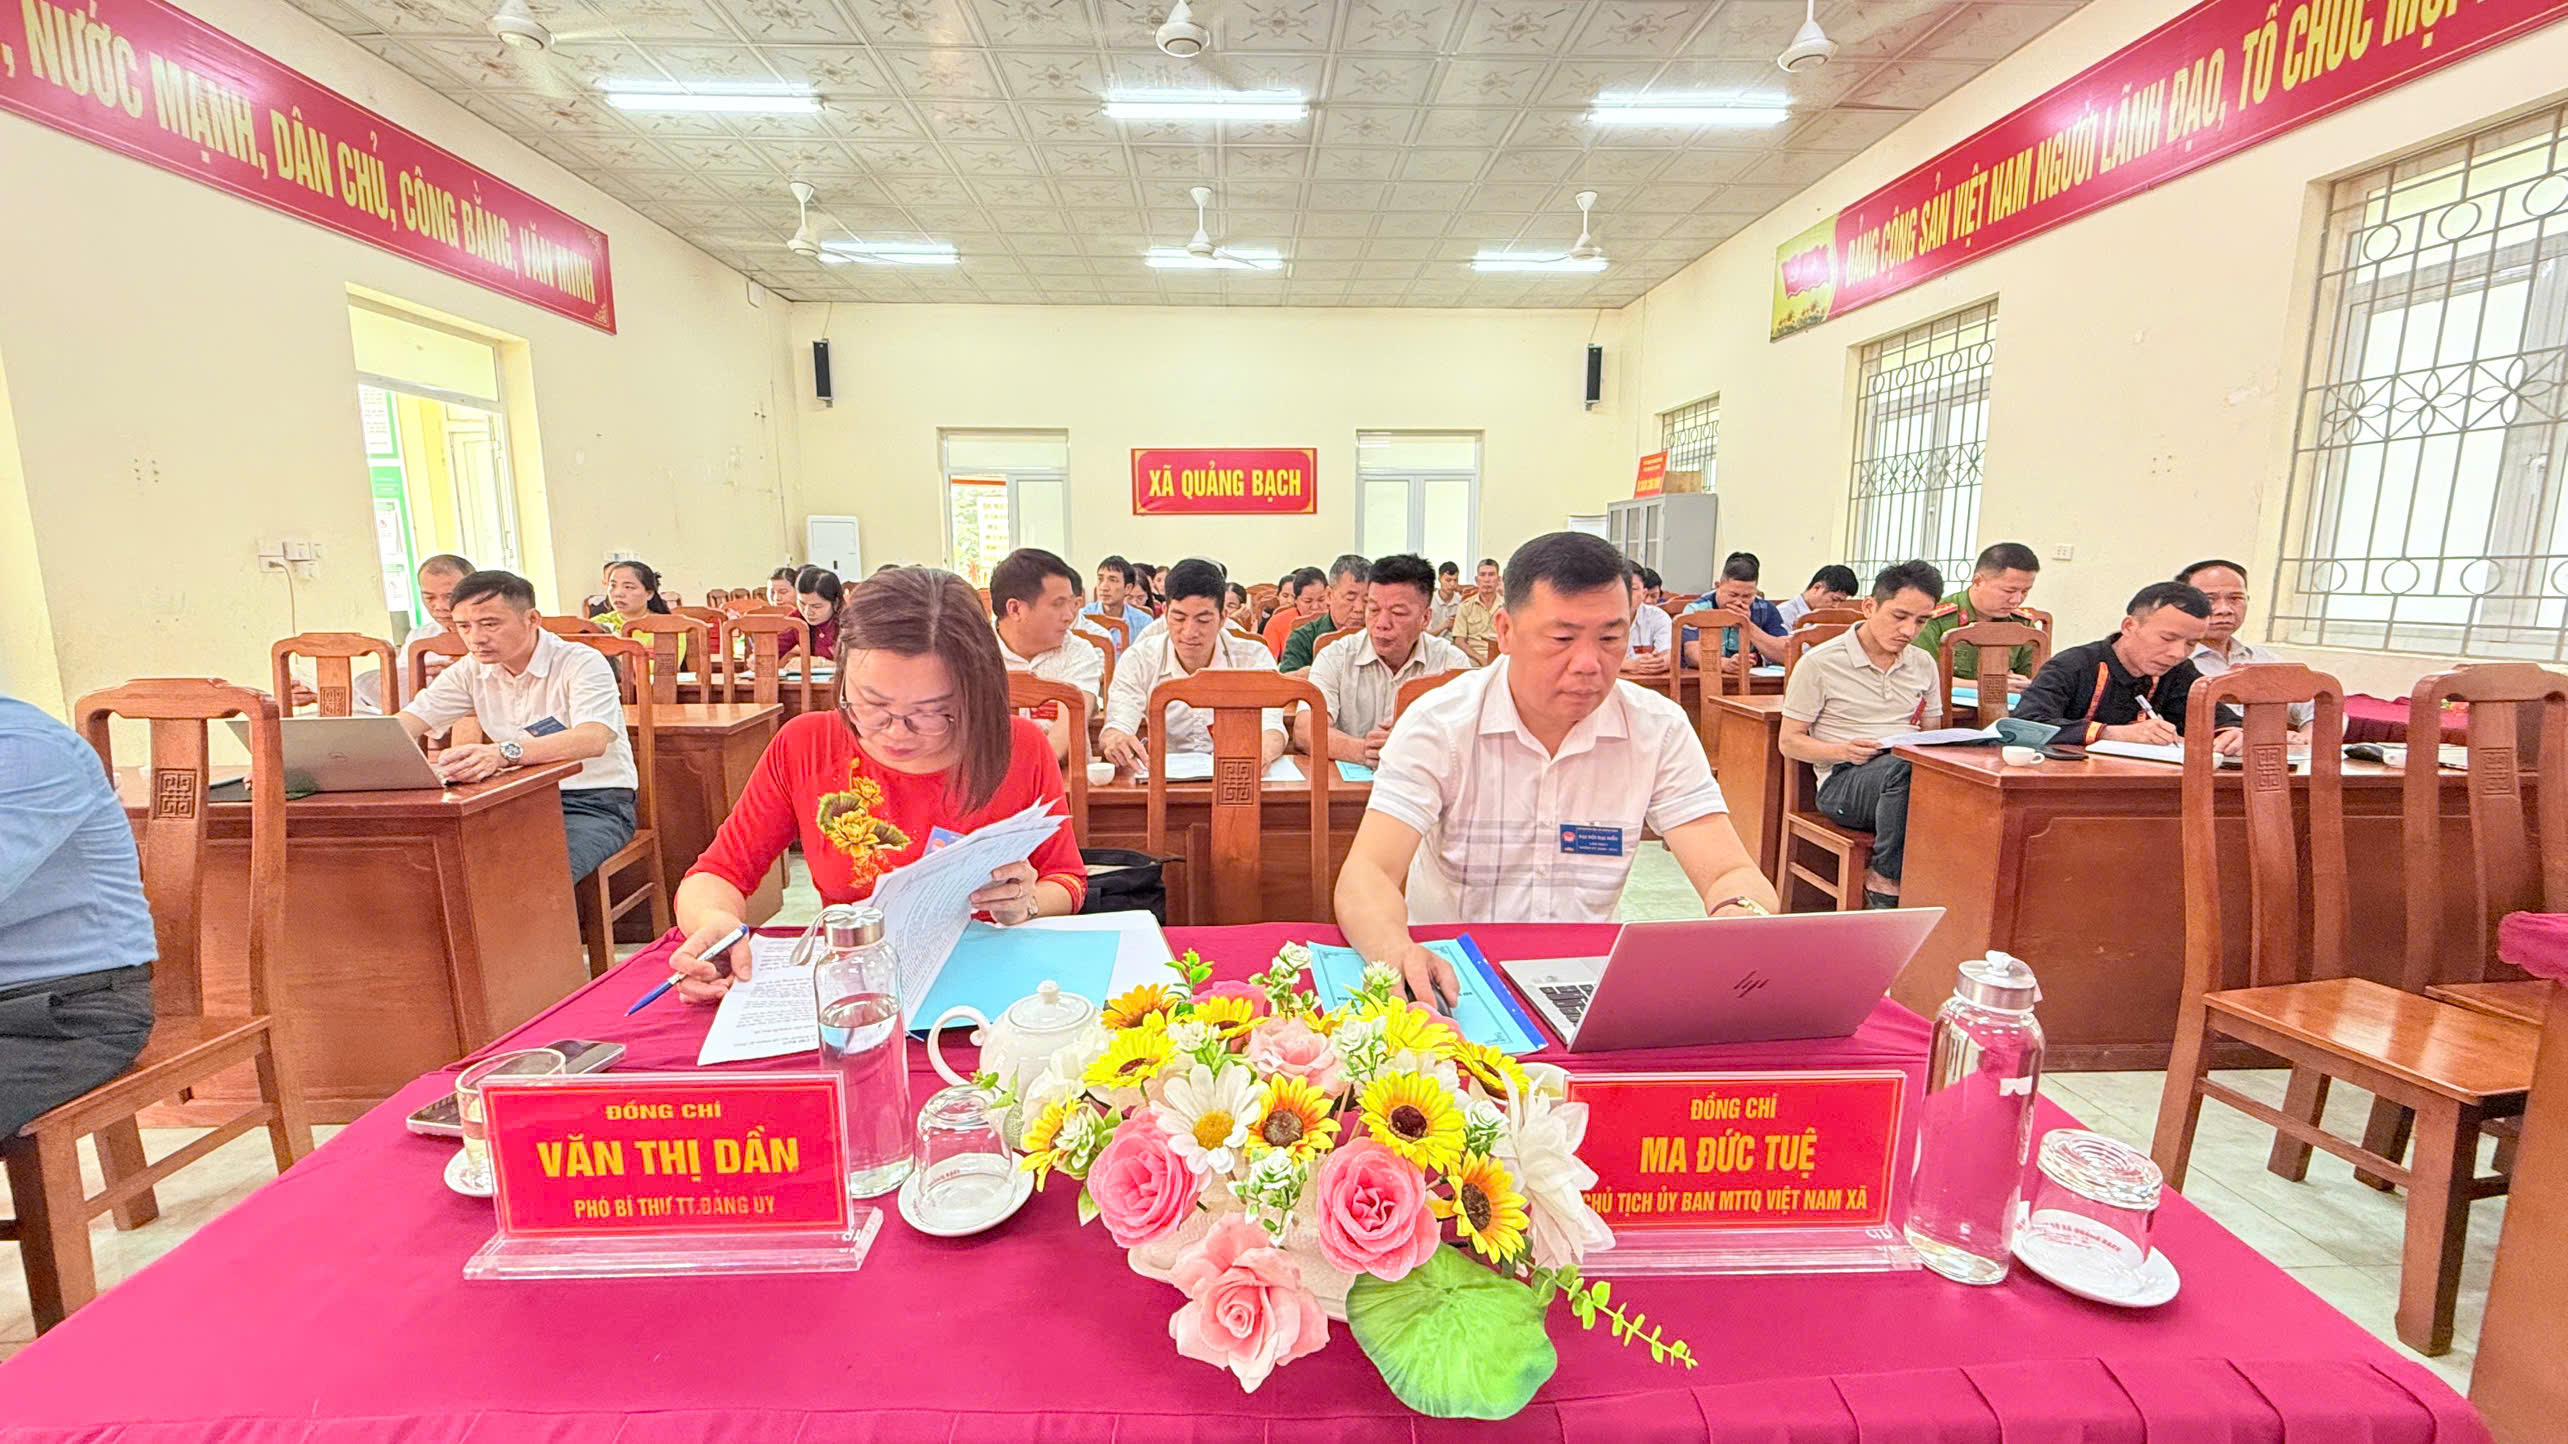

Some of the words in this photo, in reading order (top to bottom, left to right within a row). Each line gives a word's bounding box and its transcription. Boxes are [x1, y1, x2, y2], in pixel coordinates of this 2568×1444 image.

[22, 0, 143, 118] NƯỚC
[150, 52, 268, 180] MẠNH,
[269, 104, 335, 199] DÂN
[337, 130, 398, 232] CHỦ,
[399, 165, 460, 249] CÔNG
[461, 180, 519, 280] BẰNG,
[519, 220, 555, 288] VĂN
[555, 243, 596, 305] MINH
[1845, 213, 1879, 288] ĐẢNG
[1880, 205, 1918, 281] CỘNG
[1919, 171, 1952, 256] SẢN
[1952, 162, 1989, 248] VIỆT
[1988, 147, 2034, 225] NAM
[2033, 98, 2100, 205] NGƯỜI
[2100, 81, 2167, 176] LÃNH
[2167, 47, 2227, 153] ĐẠO,
[1148, 464, 1175, 497] XÃ
[1181, 460, 1245, 500] QUẢNG
[1251, 468, 1302, 503] BẠCH
[681, 1099, 721, 1119] CHÍ
[1690, 1091, 1741, 1121] ĐỒNG
[1745, 1093, 1778, 1120] CHÍ
[536, 1133, 625, 1178] VĂN
[634, 1138, 702, 1182] THỊ
[713, 1124, 800, 1175] DẦN
[1640, 1136, 1687, 1174] MA
[1696, 1128, 1756, 1174] ĐỨC
[1764, 1127, 1818, 1179] TUỆ
[574, 1196, 610, 1218] PHÓ
[614, 1194, 634, 1217] BÍ
[637, 1195, 673, 1217] THƯ
[1617, 1191, 1652, 1217] TỊCH
[1656, 1185, 1677, 1214] ỦY
[1681, 1190, 1714, 1212] BAN
[1718, 1189, 1763, 1212] MTTQ
[1766, 1185, 1800, 1215] VIỆT
[1803, 1189, 1839, 1211] NAM
[1845, 1185, 1868, 1210] XÃ
